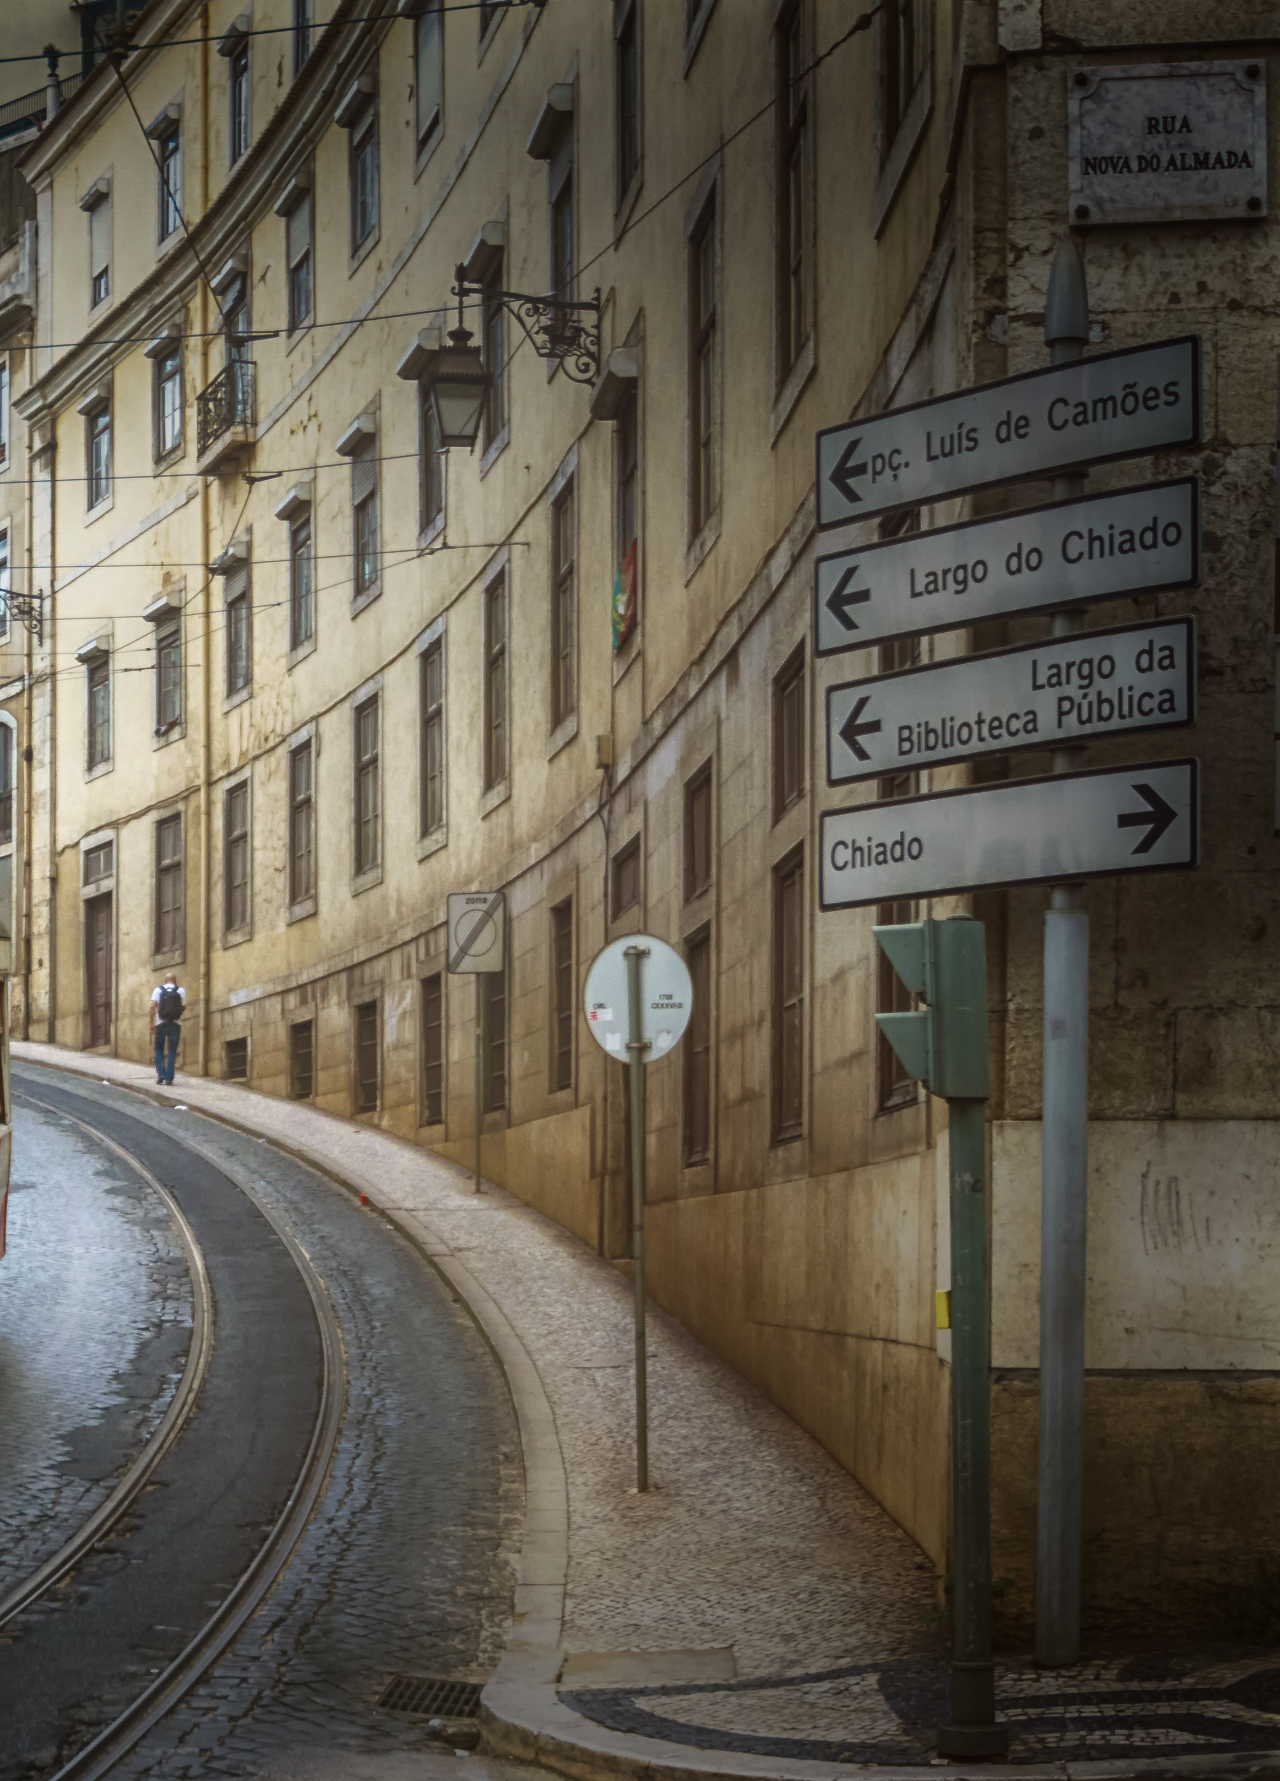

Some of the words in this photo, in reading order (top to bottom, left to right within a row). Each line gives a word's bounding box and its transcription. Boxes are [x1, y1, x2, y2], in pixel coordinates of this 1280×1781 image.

[1146, 115, 1193, 135] RUA
[1082, 155, 1133, 175] NOVA
[1136, 153, 1161, 173] DO
[1163, 150, 1253, 172] ALMADA
[870, 447, 910, 484] pç.
[925, 422, 979, 463] Luís
[995, 410, 1030, 444] de
[1047, 380, 1181, 431] Camões
[909, 559, 988, 599] Largo
[1005, 543, 1043, 576] do
[1061, 516, 1183, 565] Chiado
[1031, 653, 1116, 691] Largo
[1134, 639, 1176, 674] da
[897, 709, 1039, 756] Biblioteca
[1056, 687, 1177, 729] Pública
[830, 831, 924, 871] Chiado
[465, 897, 488, 905] zona
